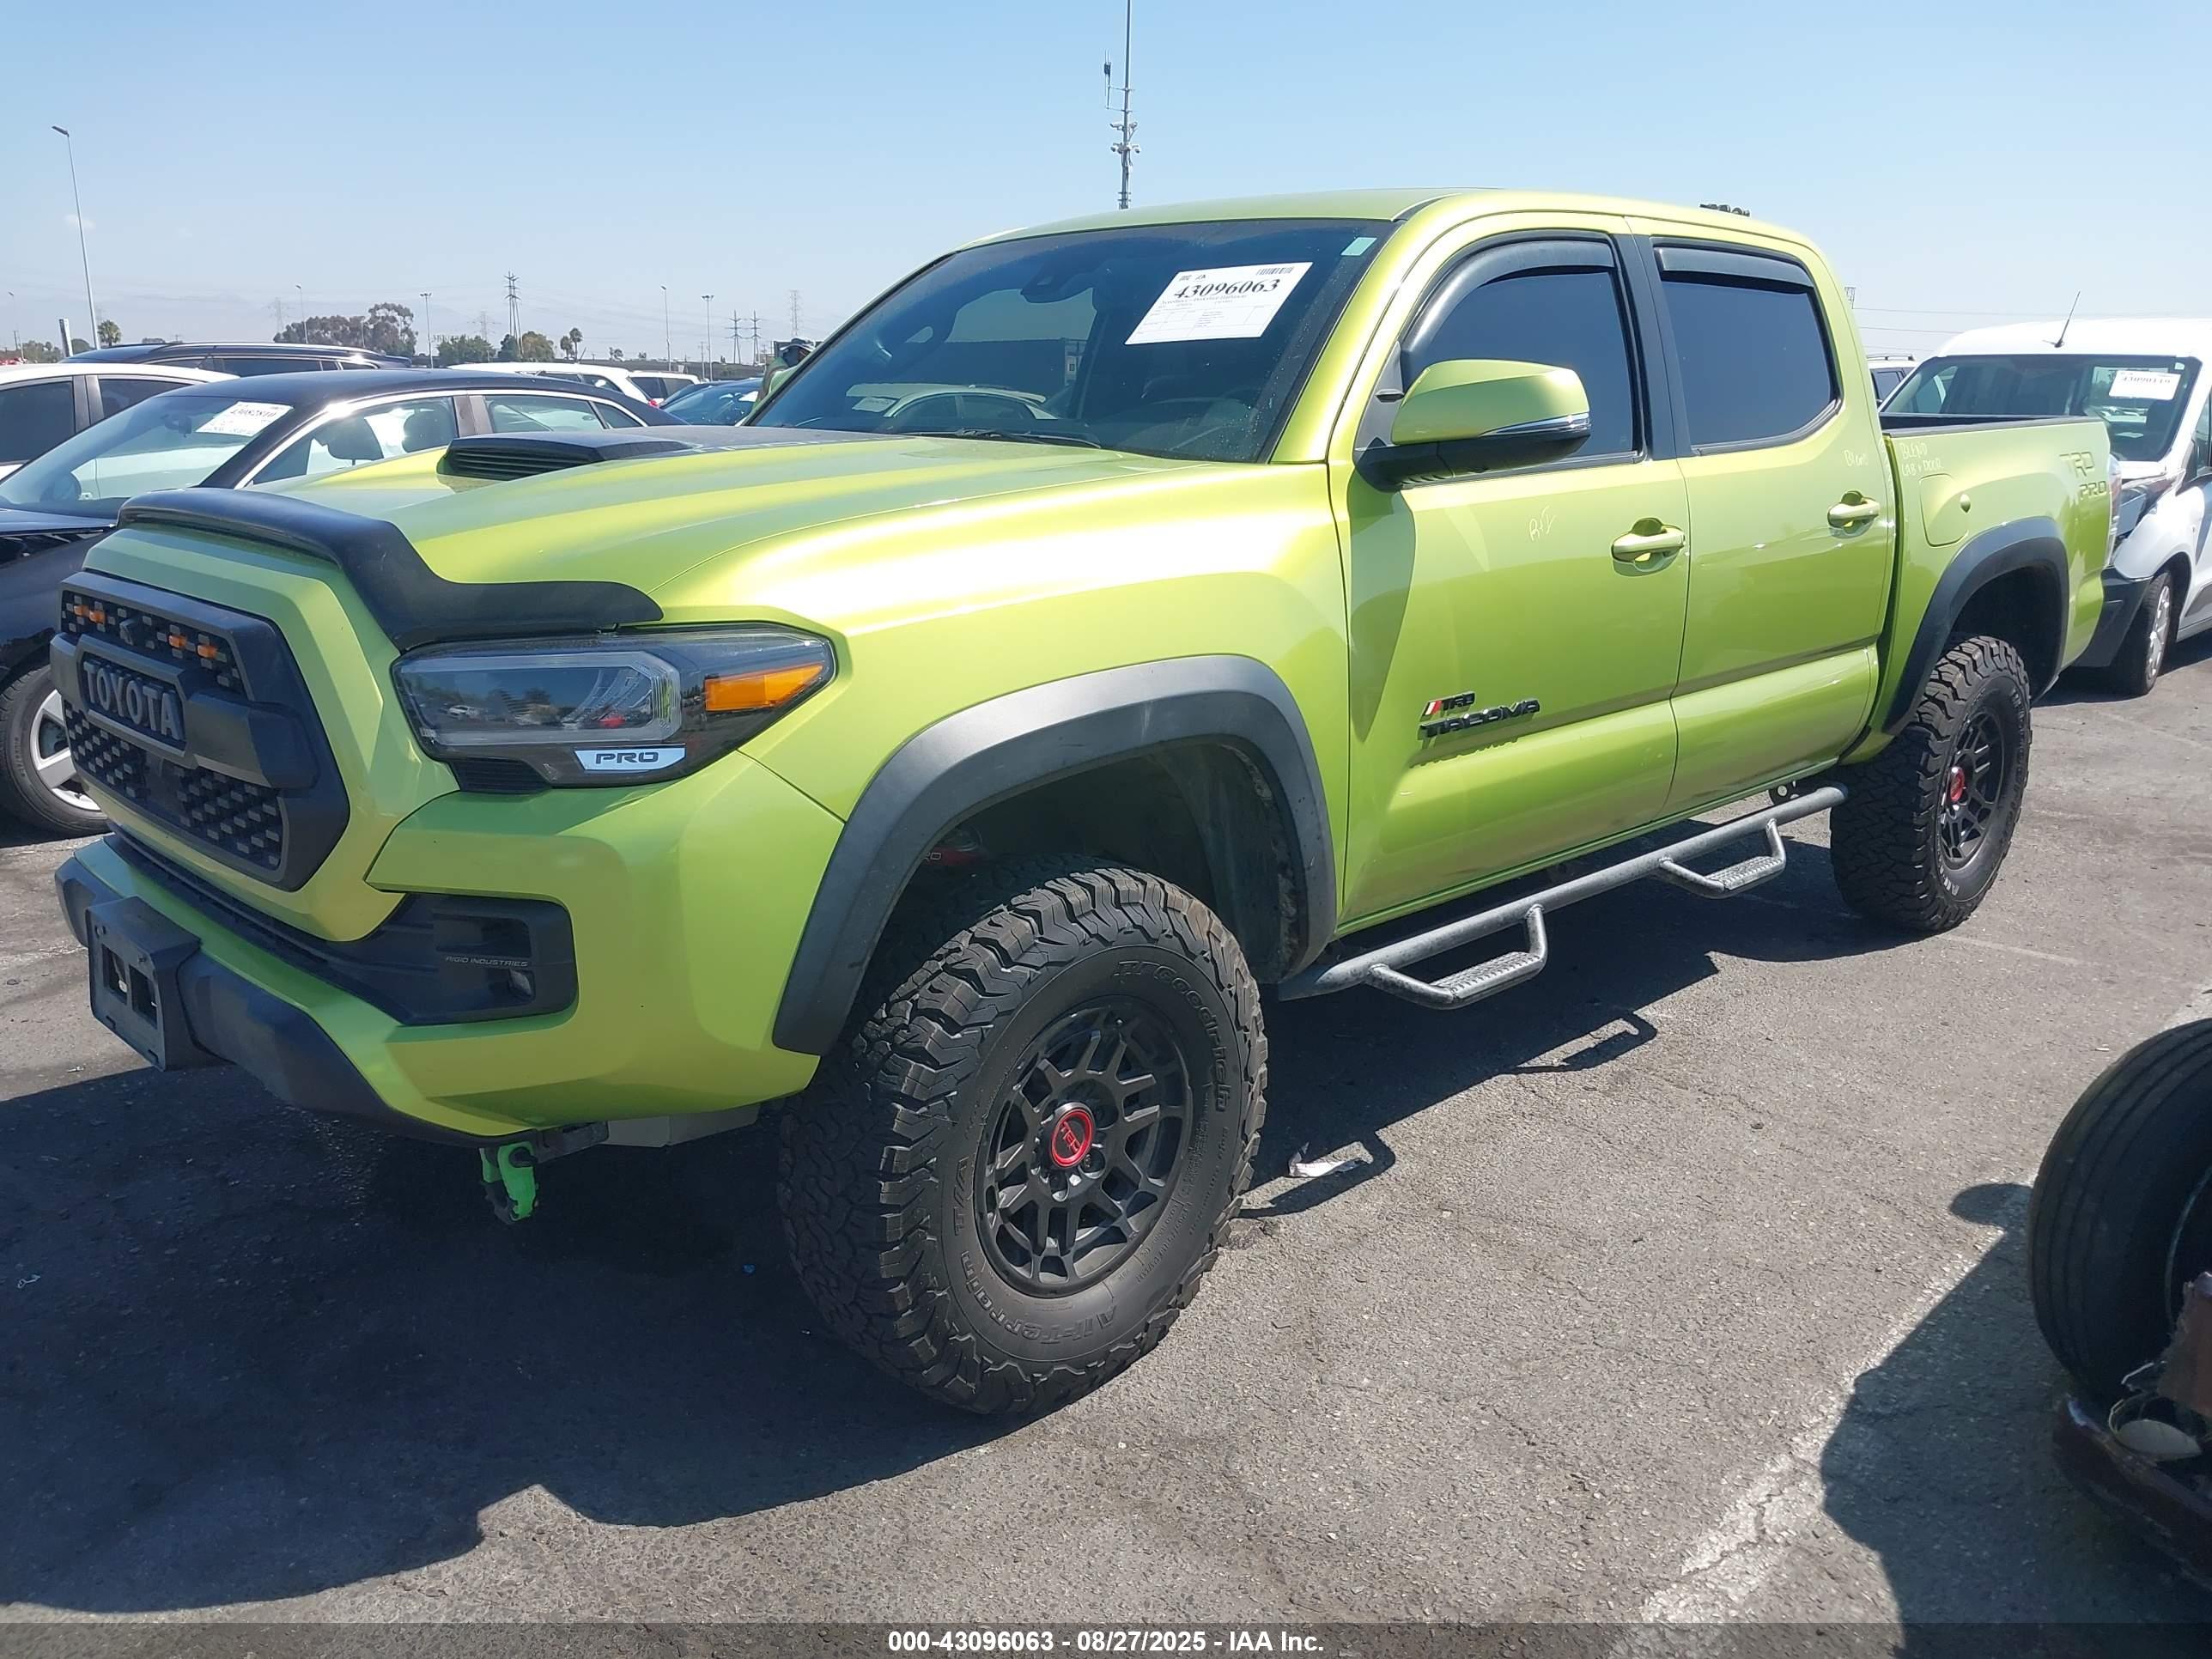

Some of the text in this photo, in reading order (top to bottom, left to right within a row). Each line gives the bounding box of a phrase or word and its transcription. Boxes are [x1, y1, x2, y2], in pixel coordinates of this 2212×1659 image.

[1174, 278, 1280, 299] 43096063
[2059, 451, 2095, 478] TRD
[2079, 480, 2107, 498] PRO
[83, 660, 184, 740] TOYOTA
[1442, 691, 1475, 711] TRD
[1419, 699, 1540, 738] TACOMA
[595, 751, 659, 764] PRO
[470, 957, 529, 967] INDUSTRIES
